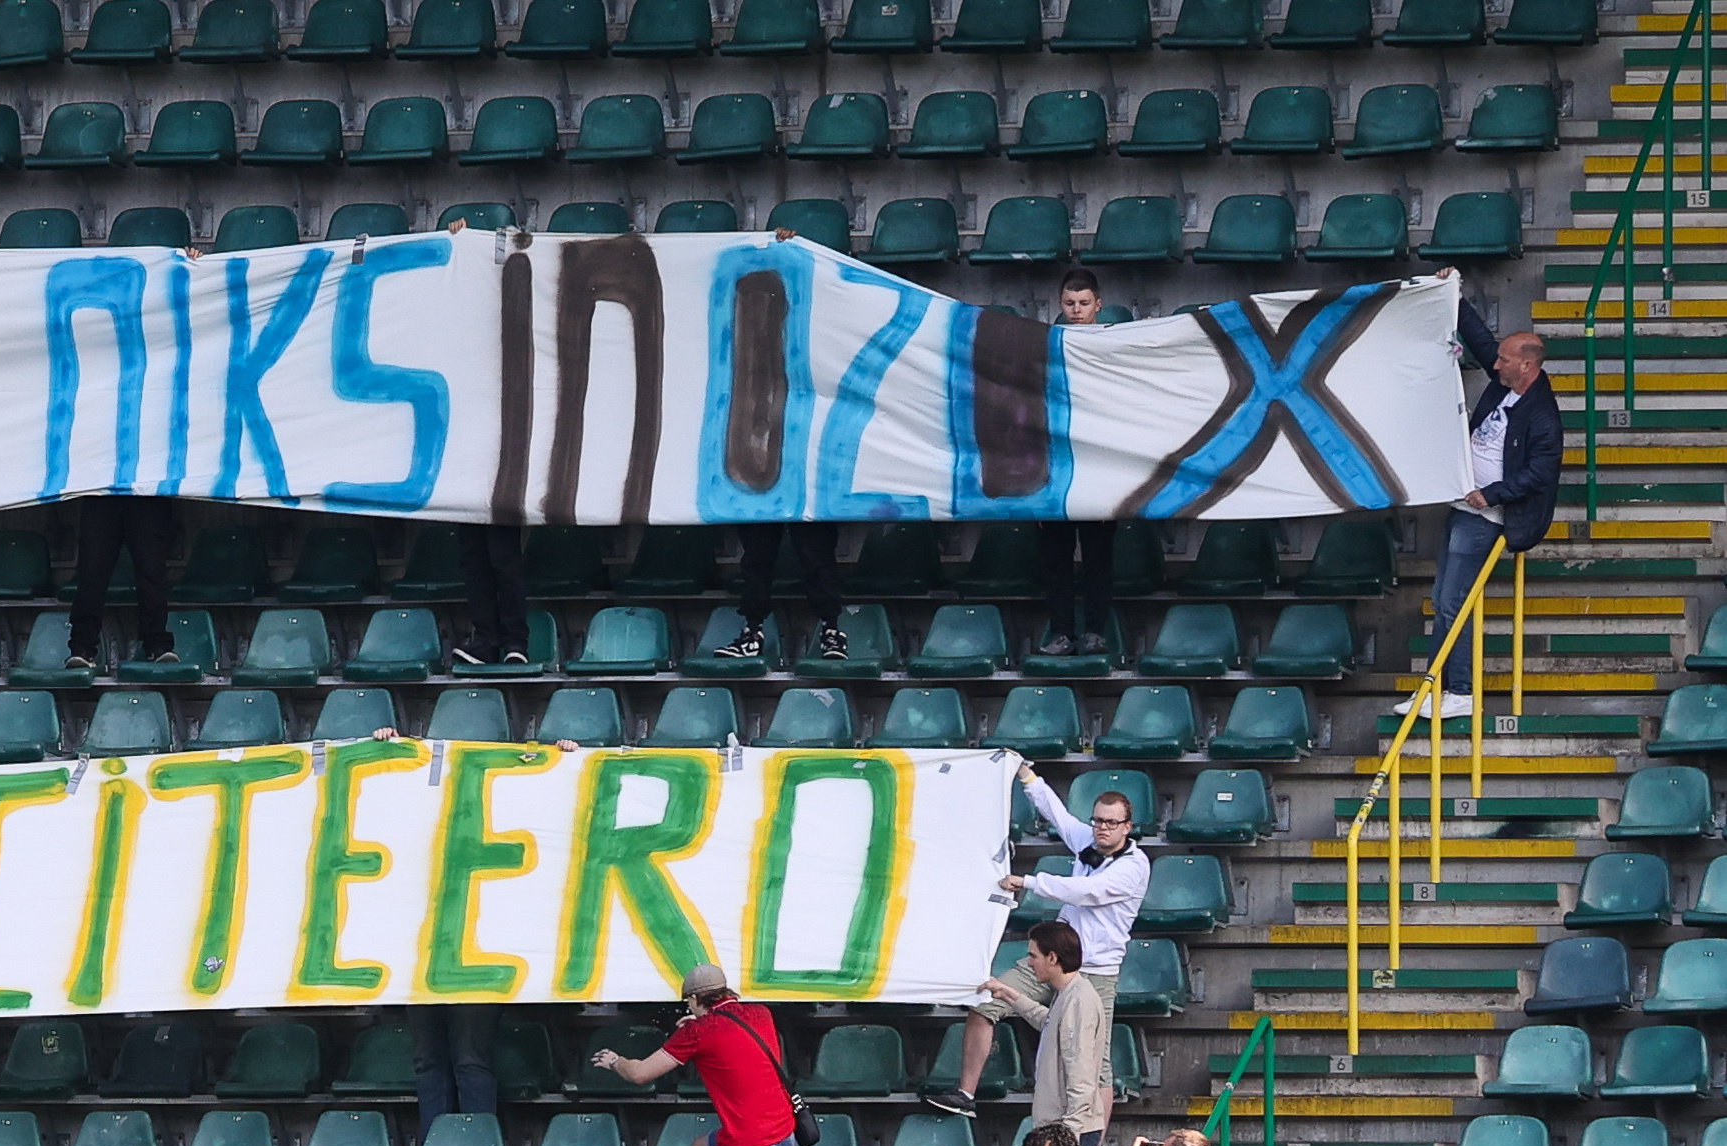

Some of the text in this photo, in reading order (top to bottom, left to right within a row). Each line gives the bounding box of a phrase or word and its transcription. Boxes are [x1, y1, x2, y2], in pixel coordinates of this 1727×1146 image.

[1689, 191, 1708, 207] 15
[1649, 301, 1672, 316] 14
[37, 236, 453, 512] NIKS
[1611, 412, 1629, 429] 13
[1497, 717, 1517, 732] 10
[1458, 800, 1472, 815] 9
[1417, 885, 1432, 902] 8
[1335, 1056, 1349, 1074] 6
